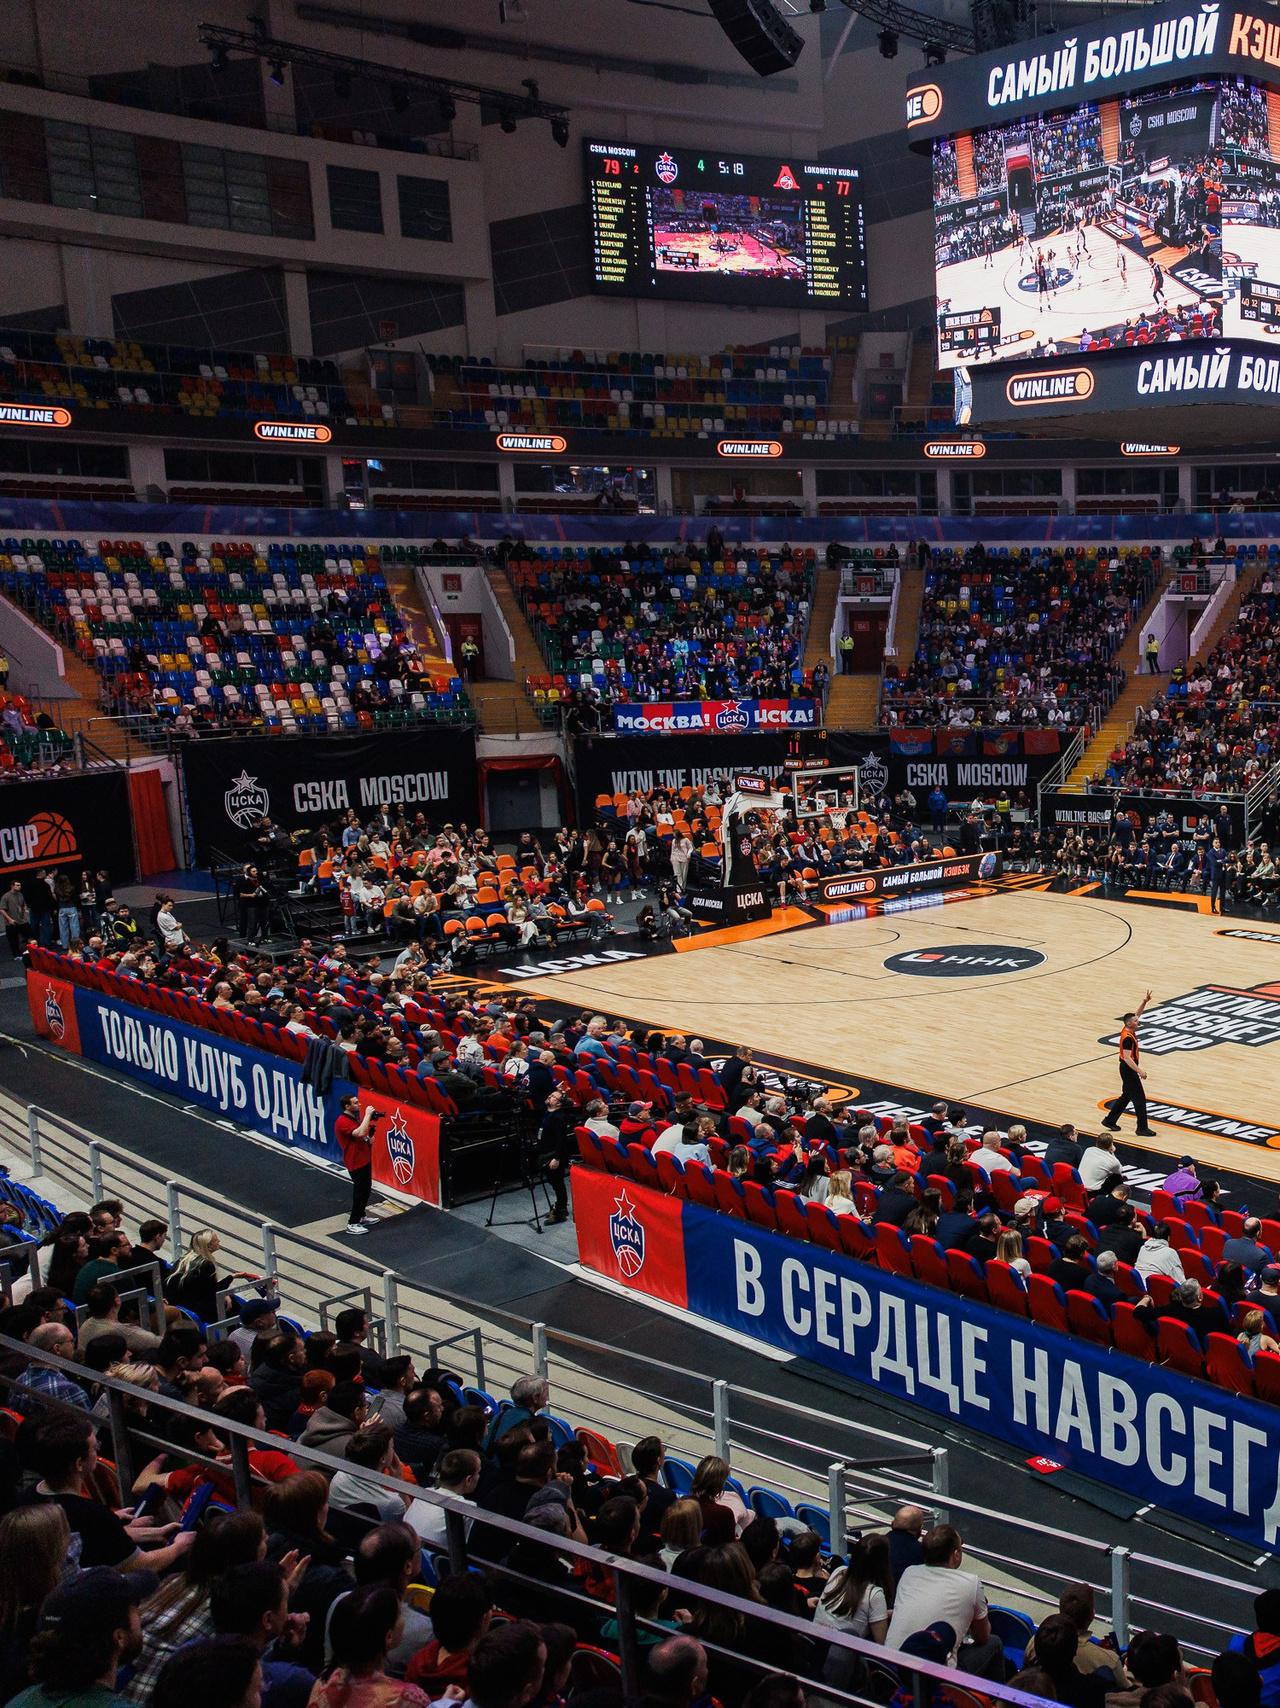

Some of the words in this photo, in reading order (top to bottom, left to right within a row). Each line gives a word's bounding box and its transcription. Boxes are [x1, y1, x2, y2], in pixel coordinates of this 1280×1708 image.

[988, 39, 1076, 108] САМЫЙ
[1083, 4, 1218, 83] БОЛЬШОЙ
[1148, 114, 1164, 129] CSKA
[1167, 107, 1197, 125] MOSCOW
[590, 144, 607, 153] CSKA
[608, 147, 636, 157] MOSCOW
[604, 159, 620, 174] 79
[634, 165, 639, 174] 2
[698, 160, 704, 171] 4
[804, 166, 837, 176] LOKOMOTIV
[838, 168, 858, 178] KUBAN
[836, 181, 850, 196] 77
[967, 328, 974, 340] 79
[992, 325, 998, 337] 77
[1137, 347, 1229, 394] САМЫЙ
[1013, 376, 1075, 400] WINLINE
[261, 424, 316, 440] WINLINE
[501, 436, 553, 449] WINLINE
[722, 443, 769, 455] WINLINE
[928, 443, 973, 456] WINLINE
[446, 580, 458, 590] B3
[860, 582, 870, 592] B4
[1184, 581, 1193, 590] C1
[617, 714, 710, 730] МОСКВА!
[720, 715, 746, 724] ЦСКА
[754, 709, 814, 724] ЦСКА!
[860, 770, 884, 779] ЦСКА
[907, 764, 948, 786] CSKA
[957, 764, 1028, 786] MOSCOW
[294, 779, 349, 813] CSKA
[360, 771, 449, 807] MOSCOW
[232, 795, 264, 808] ЦСКА
[1055, 810, 1087, 823] WINLINE
[0, 825, 39, 863] CUP
[882, 870, 908, 887] САМЫЙ
[910, 866, 943, 884] БОЛЬШОЙ
[944, 864, 970, 878] КЭШБЭК
[828, 884, 866, 897] WINLINE
[692, 896, 706, 907] ЦСКА
[706, 898, 723, 910] МОСКВА
[737, 892, 764, 908] ЦСКА
[498, 950, 648, 978] ЦСКА
[940, 955, 1030, 968] ННК
[1108, 1029, 1214, 1051] CUP
[97, 1005, 180, 1082] ТОЛЬКО
[183, 1037, 248, 1110] КЛУБ
[253, 1065, 328, 1144] ОДИН
[388, 1137, 413, 1158] ЦСКА
[613, 1222, 642, 1248] ЦСКА
[733, 1238, 766, 1317] В
[780, 1256, 992, 1415] СЕРДЦЕ
